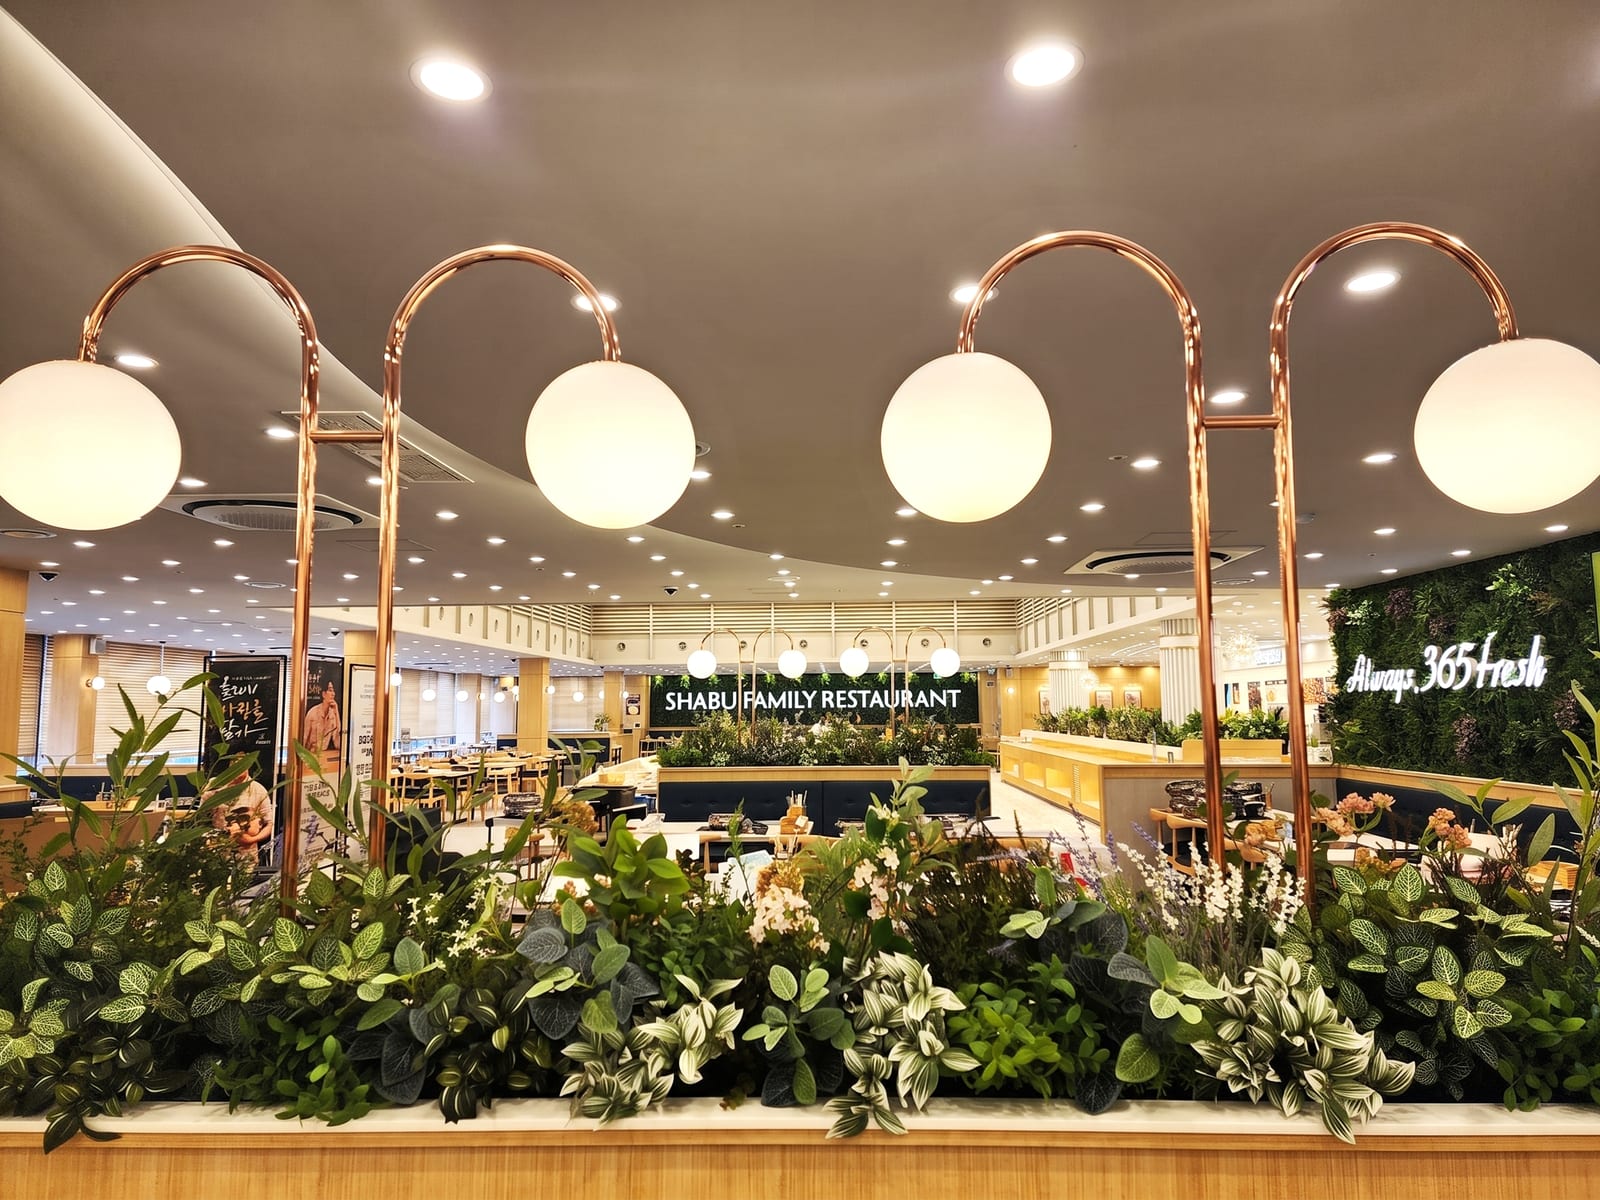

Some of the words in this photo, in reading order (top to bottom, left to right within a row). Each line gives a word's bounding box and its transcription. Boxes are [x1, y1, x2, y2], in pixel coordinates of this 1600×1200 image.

[1421, 644, 1476, 692] 365
[665, 691, 737, 711] SHABU
[743, 690, 818, 709] FAMILY
[821, 689, 962, 709] RESTAURANT
